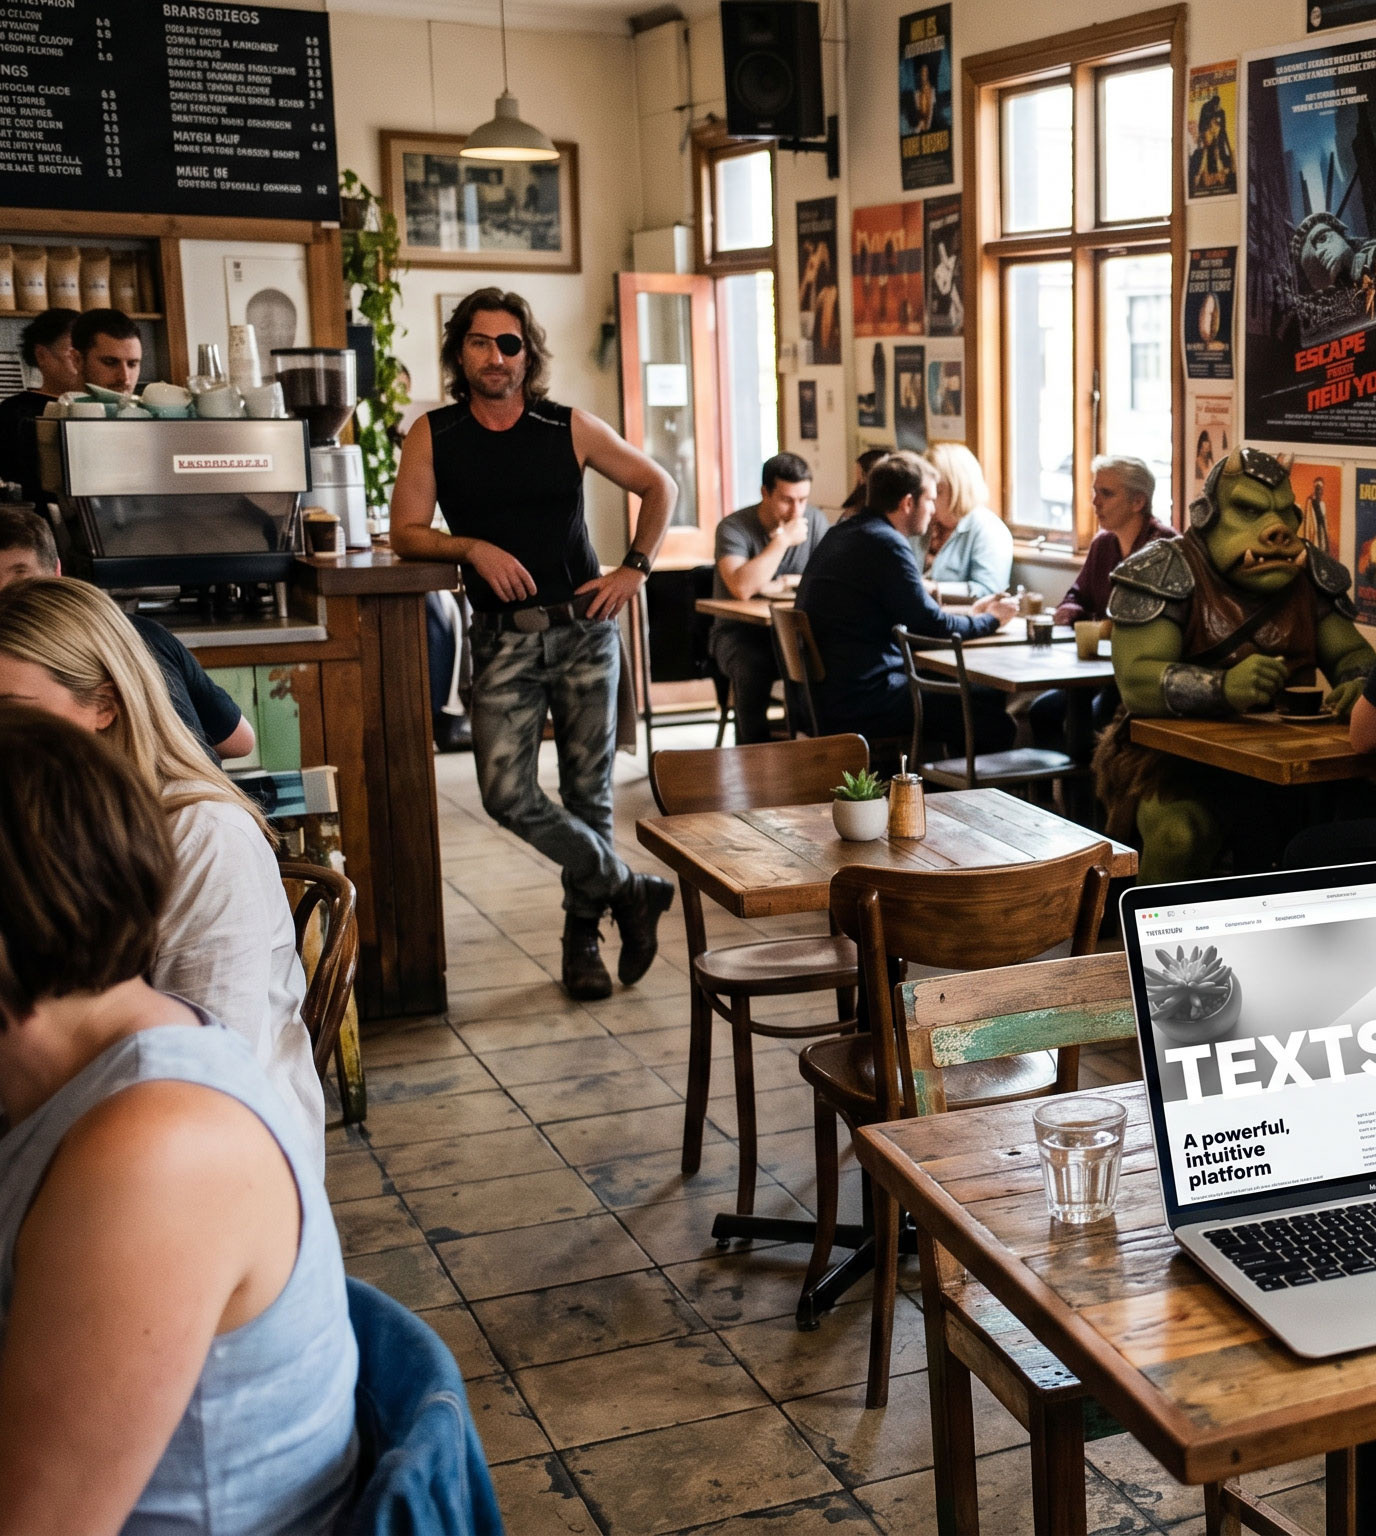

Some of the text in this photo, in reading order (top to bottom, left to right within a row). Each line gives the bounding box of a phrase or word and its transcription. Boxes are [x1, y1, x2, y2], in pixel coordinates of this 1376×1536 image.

[1295, 331, 1366, 373] ESCAPE
[1307, 380, 1351, 412] NEW
[1183, 1118, 1290, 1150] A powerful,
[1186, 1144, 1266, 1169] intuitive
[1189, 1161, 1272, 1191] platform
